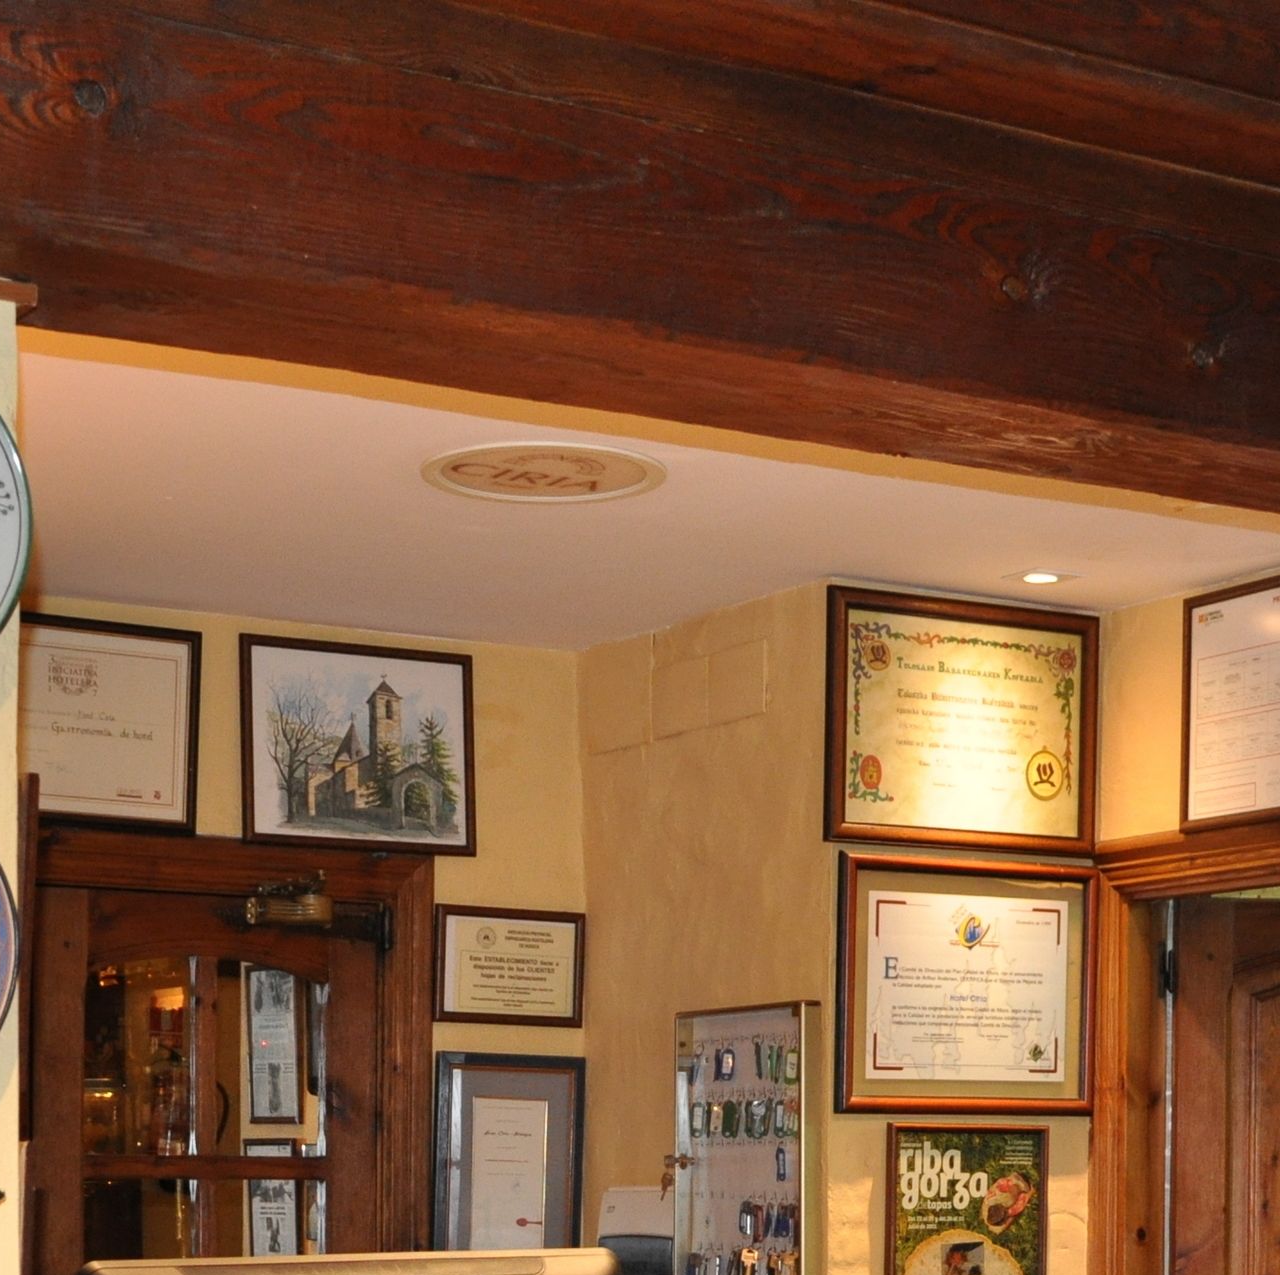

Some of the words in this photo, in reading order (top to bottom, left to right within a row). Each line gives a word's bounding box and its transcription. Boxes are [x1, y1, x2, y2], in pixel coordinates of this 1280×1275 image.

[451, 463, 598, 491] CIRIA
[484, 956, 538, 966] ESTABLECIMIENTO
[900, 1141, 961, 1177] riba
[900, 1171, 988, 1210] gorza
[927, 1199, 953, 1212] tapas
